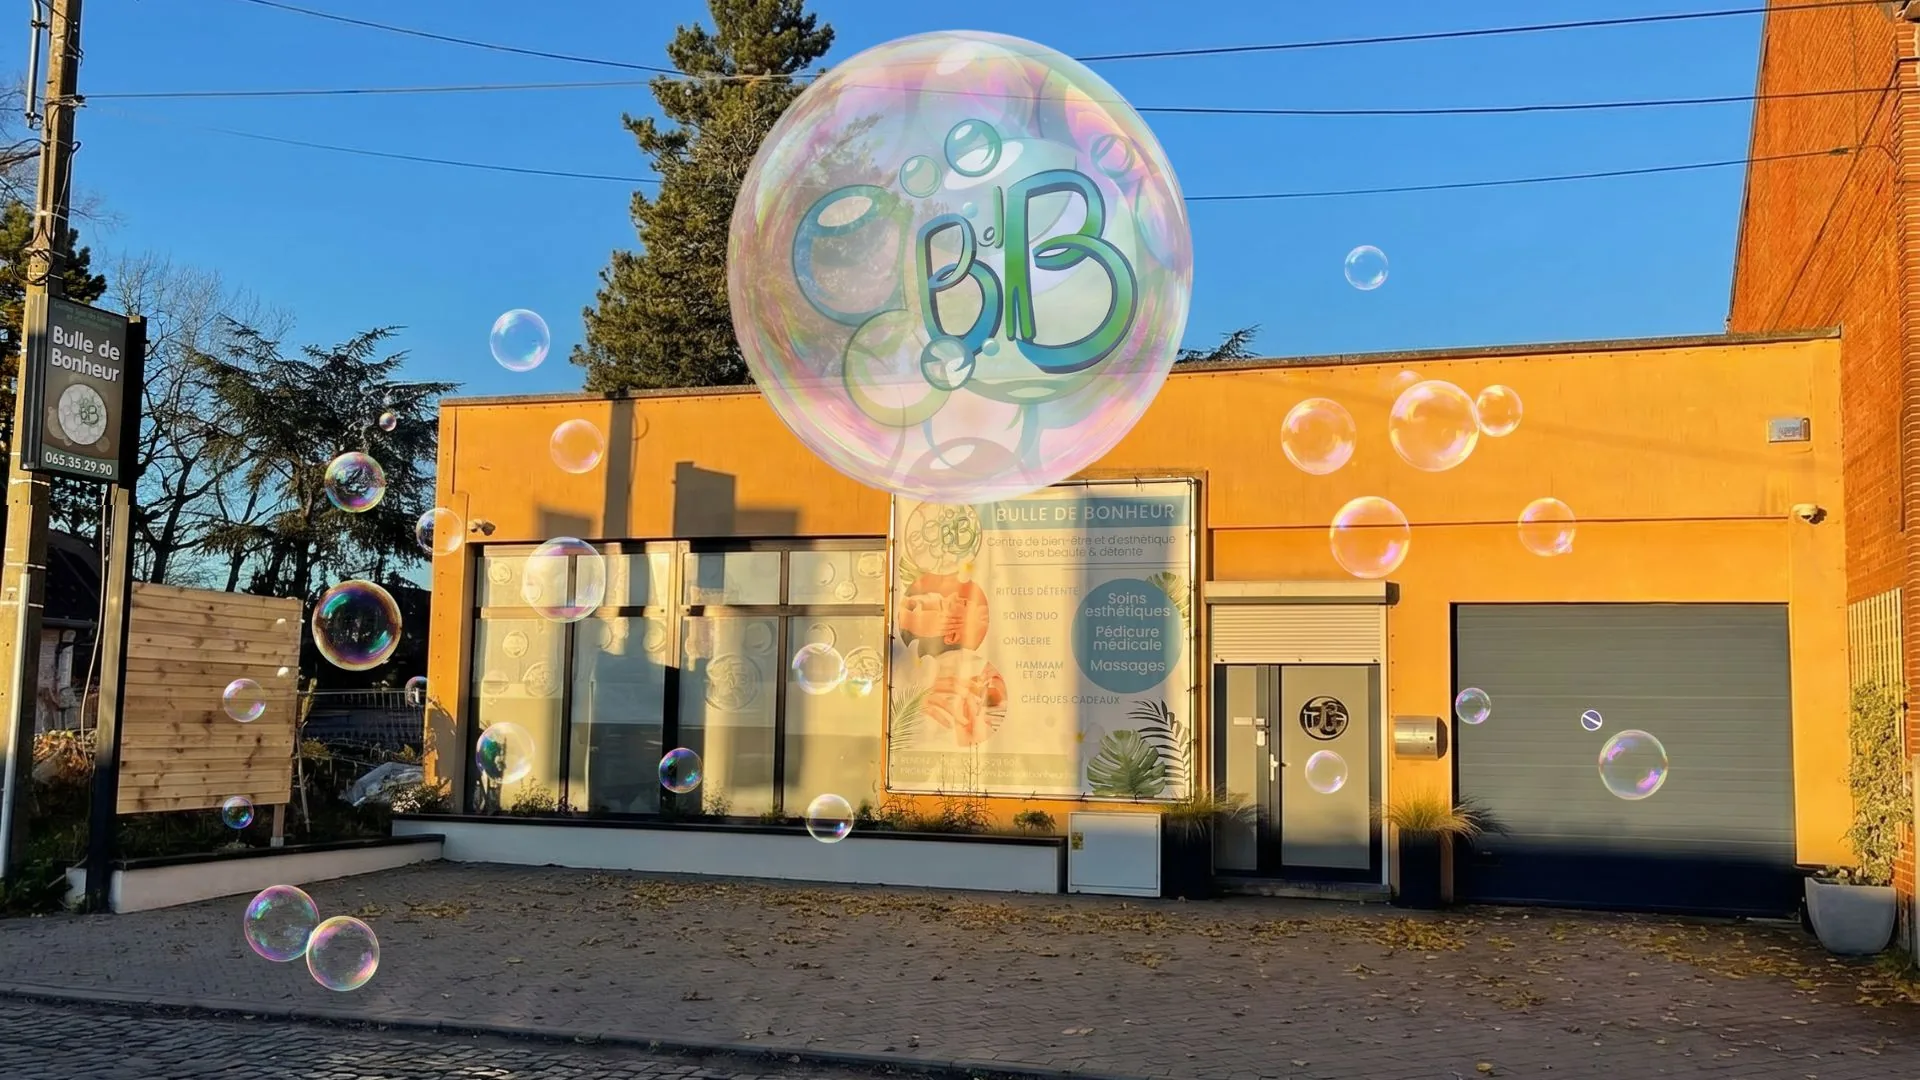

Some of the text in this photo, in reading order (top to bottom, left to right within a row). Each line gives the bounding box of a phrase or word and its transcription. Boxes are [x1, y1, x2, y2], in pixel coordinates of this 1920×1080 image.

[53, 325, 120, 361] Bulle de
[51, 347, 120, 382] Bonheur
[45, 451, 113, 476] 065.35.29.90
[996, 504, 1175, 522] BULLE DE BONHEUR
[986, 537, 1022, 547] Centre
[1025, 536, 1039, 547] de
[1094, 535, 1105, 545] et
[1016, 547, 1045, 558] soins
[1088, 547, 1097, 557] &
[995, 584, 1079, 596] RITUELS DÉTENTE
[1107, 592, 1147, 605] Soins
[1003, 611, 1058, 621] SOINS DUO
[1084, 604, 1171, 620] esthétiques
[1095, 625, 1160, 638] Pédicure
[1003, 636, 1051, 646] ONGLERIE
[1093, 638, 1162, 651] médicale
[1015, 661, 1064, 670] HAMMAM
[1090, 660, 1165, 676] Massages
[1022, 670, 1056, 680] ET SPA
[1071, 695, 1120, 705] CADEAUX
